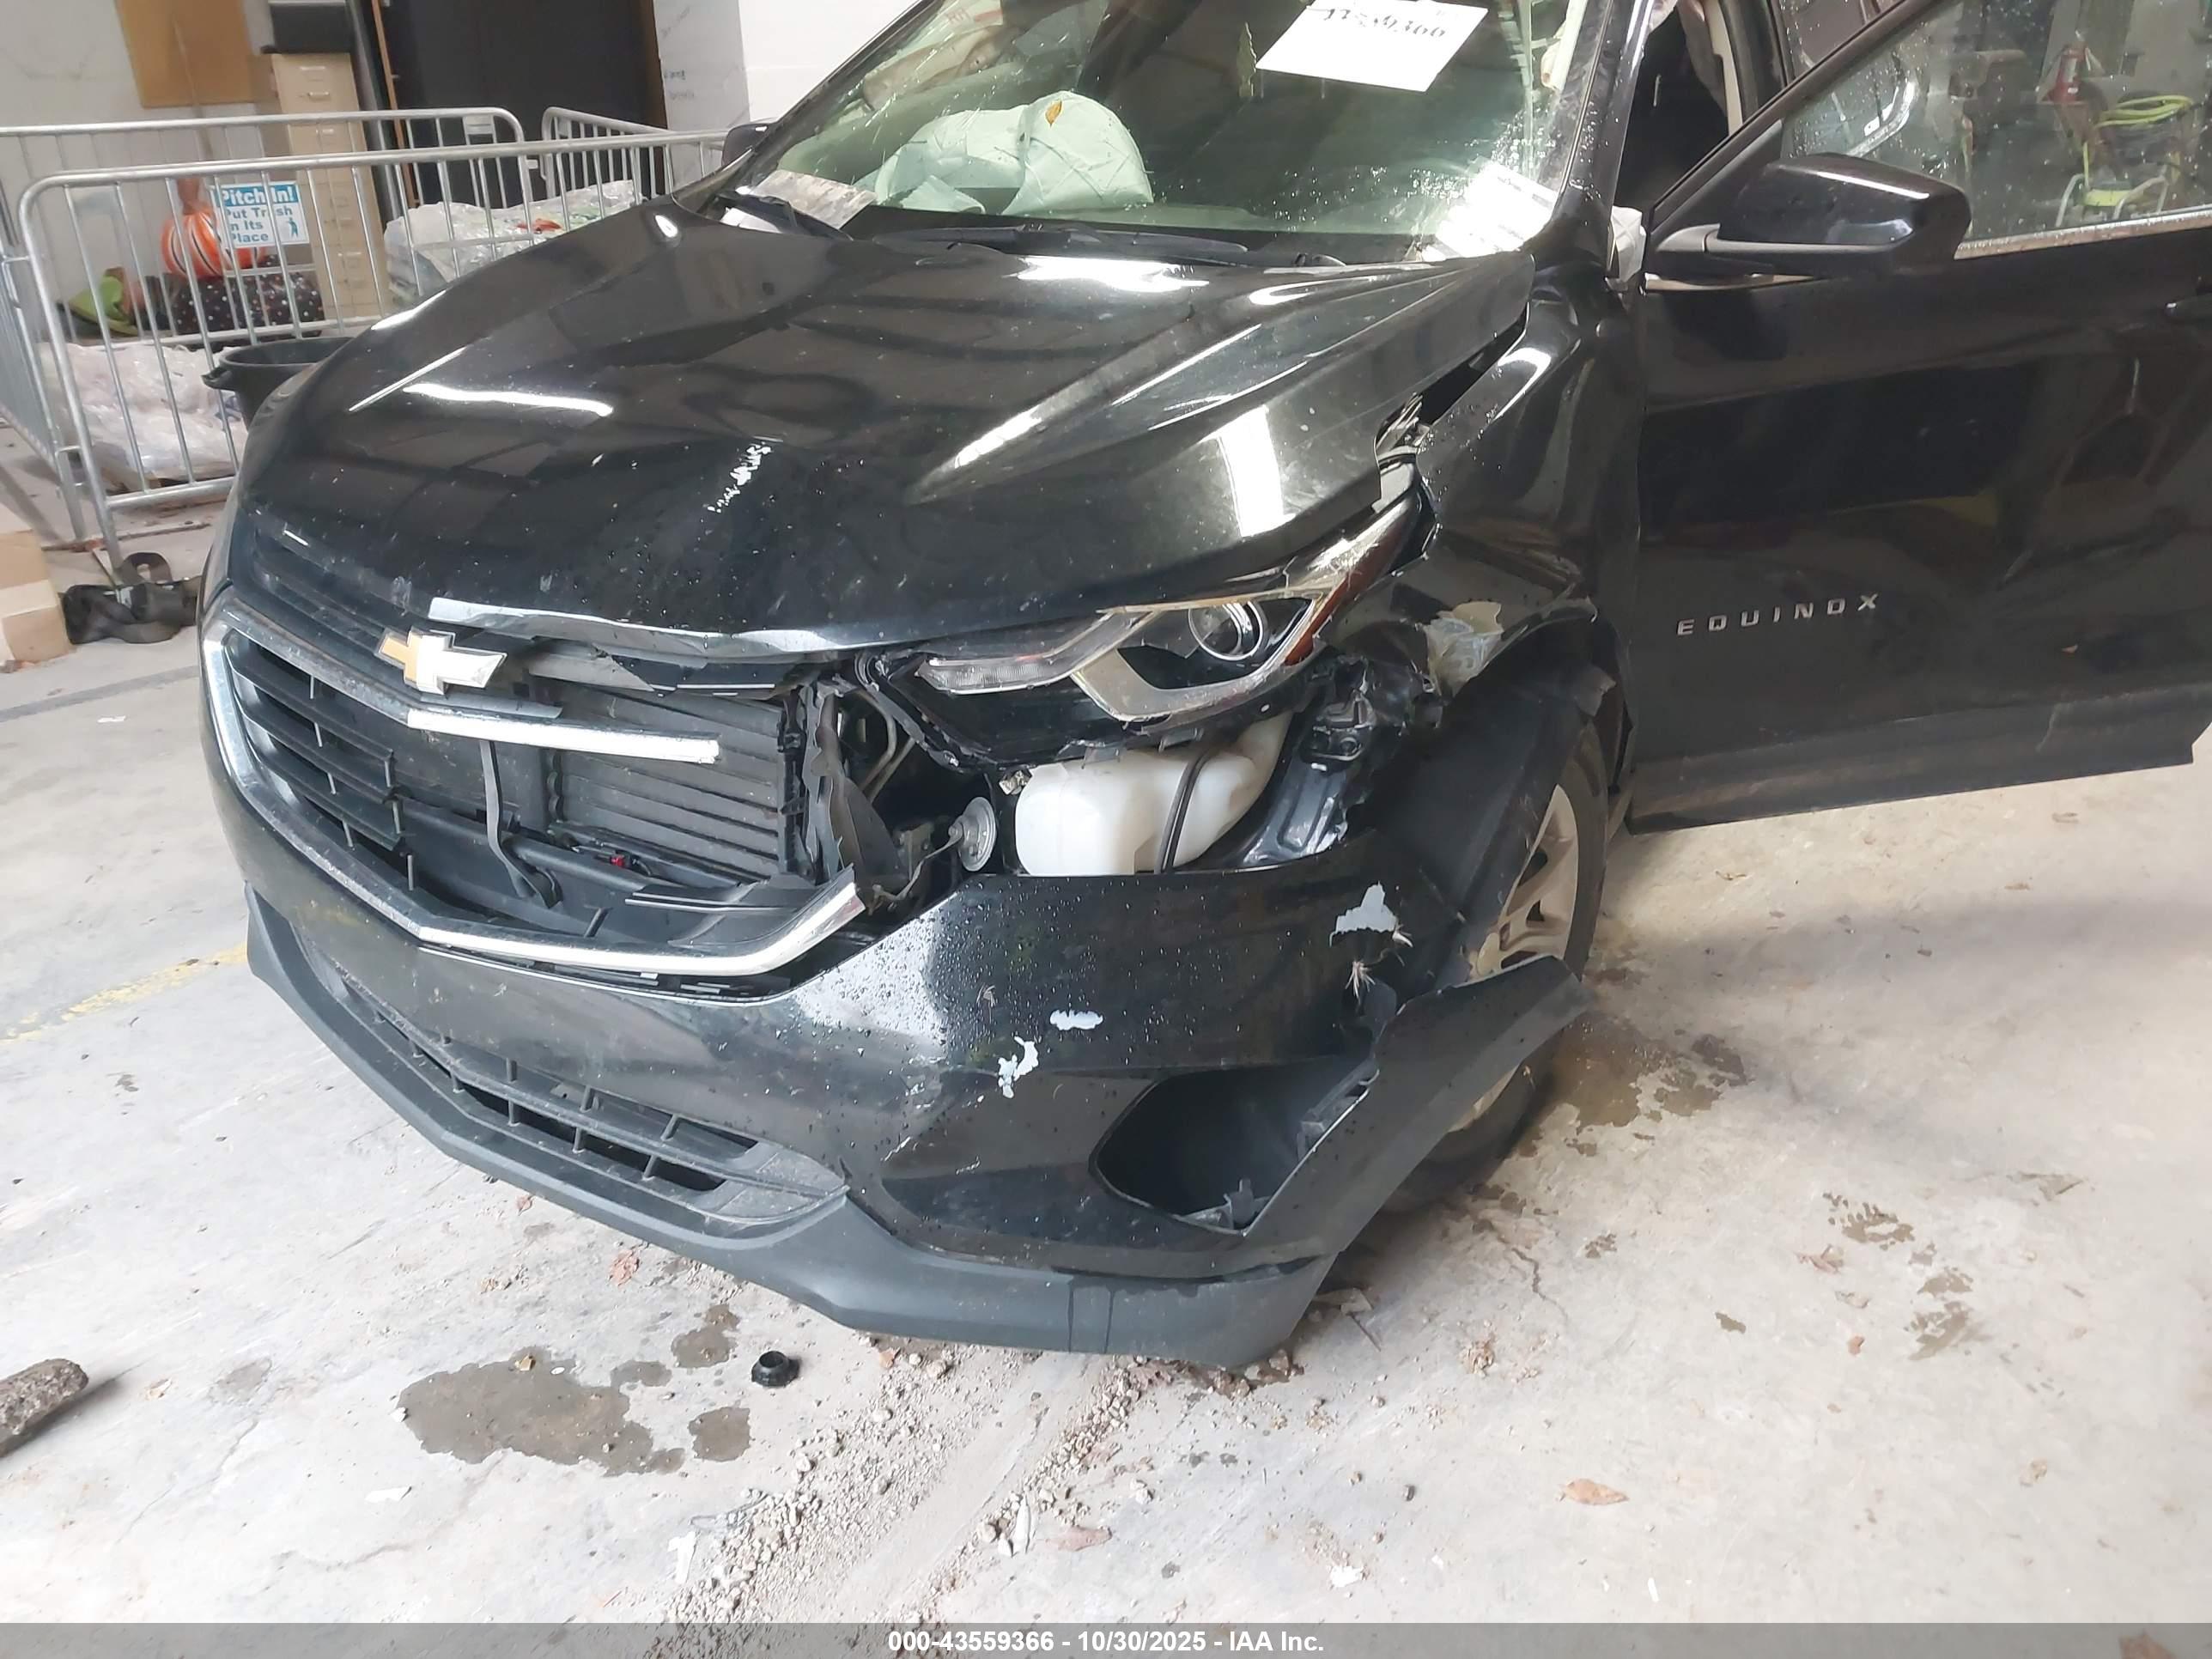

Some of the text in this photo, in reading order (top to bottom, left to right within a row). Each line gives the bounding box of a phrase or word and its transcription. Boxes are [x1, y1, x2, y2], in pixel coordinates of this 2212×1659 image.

[222, 185, 295, 206] Pitch In!
[252, 206, 293, 218] Trsh
[245, 221, 263, 230] Its
[1677, 593, 1878, 635] EQUINOX
